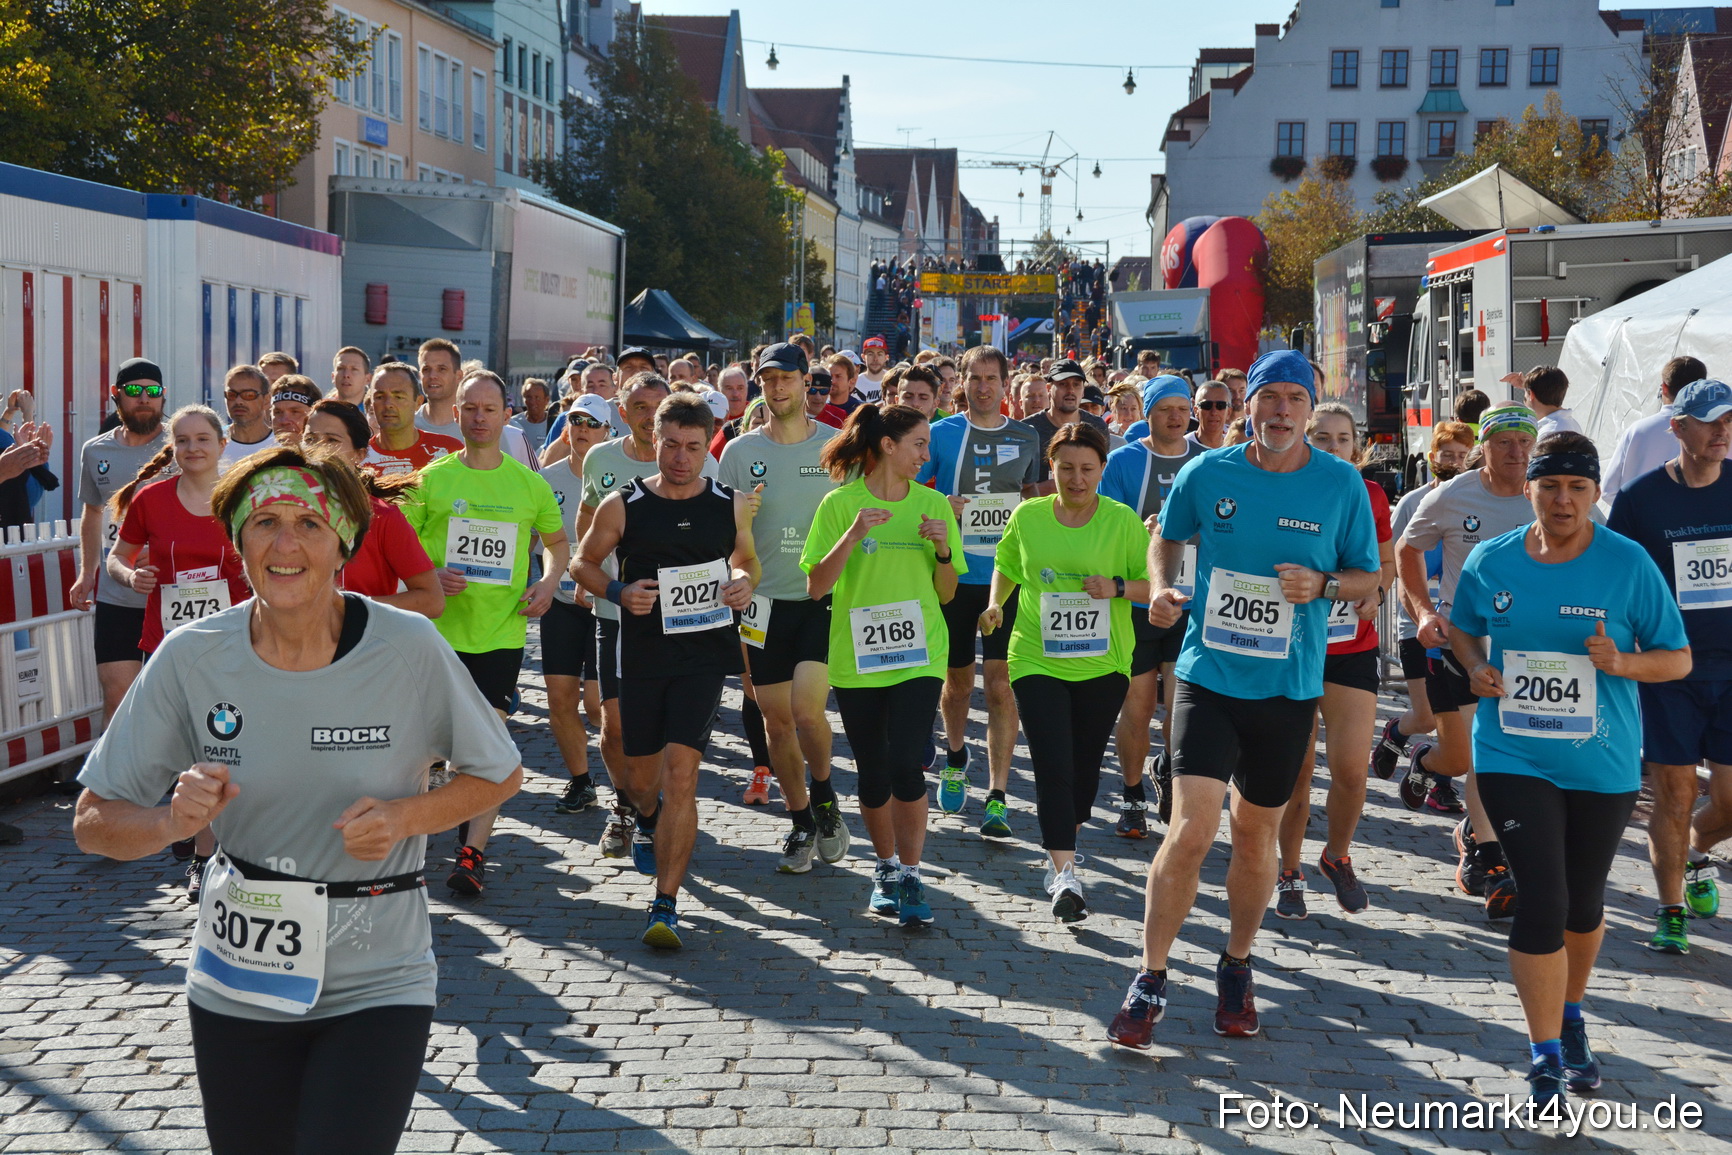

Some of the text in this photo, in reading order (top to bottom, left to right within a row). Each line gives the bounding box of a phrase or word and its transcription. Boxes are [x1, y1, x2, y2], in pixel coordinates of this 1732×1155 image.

[964, 278, 1012, 290] START
[1139, 312, 1182, 322] BOCK
[272, 391, 308, 404] adidas
[970, 508, 1012, 527] 2009
[469, 524, 499, 534] BOCK
[1277, 516, 1322, 534] BOCK
[782, 527, 800, 538] 19.
[457, 535, 506, 559] 2169
[1696, 544, 1730, 554] BOCK
[187, 571, 207, 580] DEHN
[466, 566, 493, 577] Rainer
[679, 569, 711, 581] BOCK
[179, 587, 208, 596] BOCK
[670, 579, 720, 607] 2027
[1233, 580, 1270, 593] BOCK
[1060, 598, 1090, 606] BOCK
[171, 598, 221, 621] 2473
[871, 608, 903, 620] BOCK
[1218, 593, 1280, 625] 2065
[1559, 605, 1608, 620] BOCK
[672, 611, 725, 627] Hans-Jürgen
[1050, 610, 1100, 631] 2167
[863, 620, 916, 646] 2168
[1221, 620, 1265, 633] PARTL Neumarkt
[1060, 642, 1090, 651] Larissa
[1230, 633, 1260, 648] Frank
[880, 652, 905, 664] Maria
[1527, 659, 1568, 671] BOCK
[1513, 675, 1581, 703] 2064
[1518, 703, 1567, 713] PARTL Neumarkt
[1528, 716, 1563, 730] Gisela
[312, 725, 391, 745] BOCK
[204, 745, 242, 759] PARTL
[311, 745, 336, 753] inspired
[338, 745, 345, 753] by
[365, 743, 391, 752] concepts
[227, 881, 282, 908] BOCK
[212, 899, 302, 957] 3073
[216, 943, 281, 969] PARTL Neumarkt
